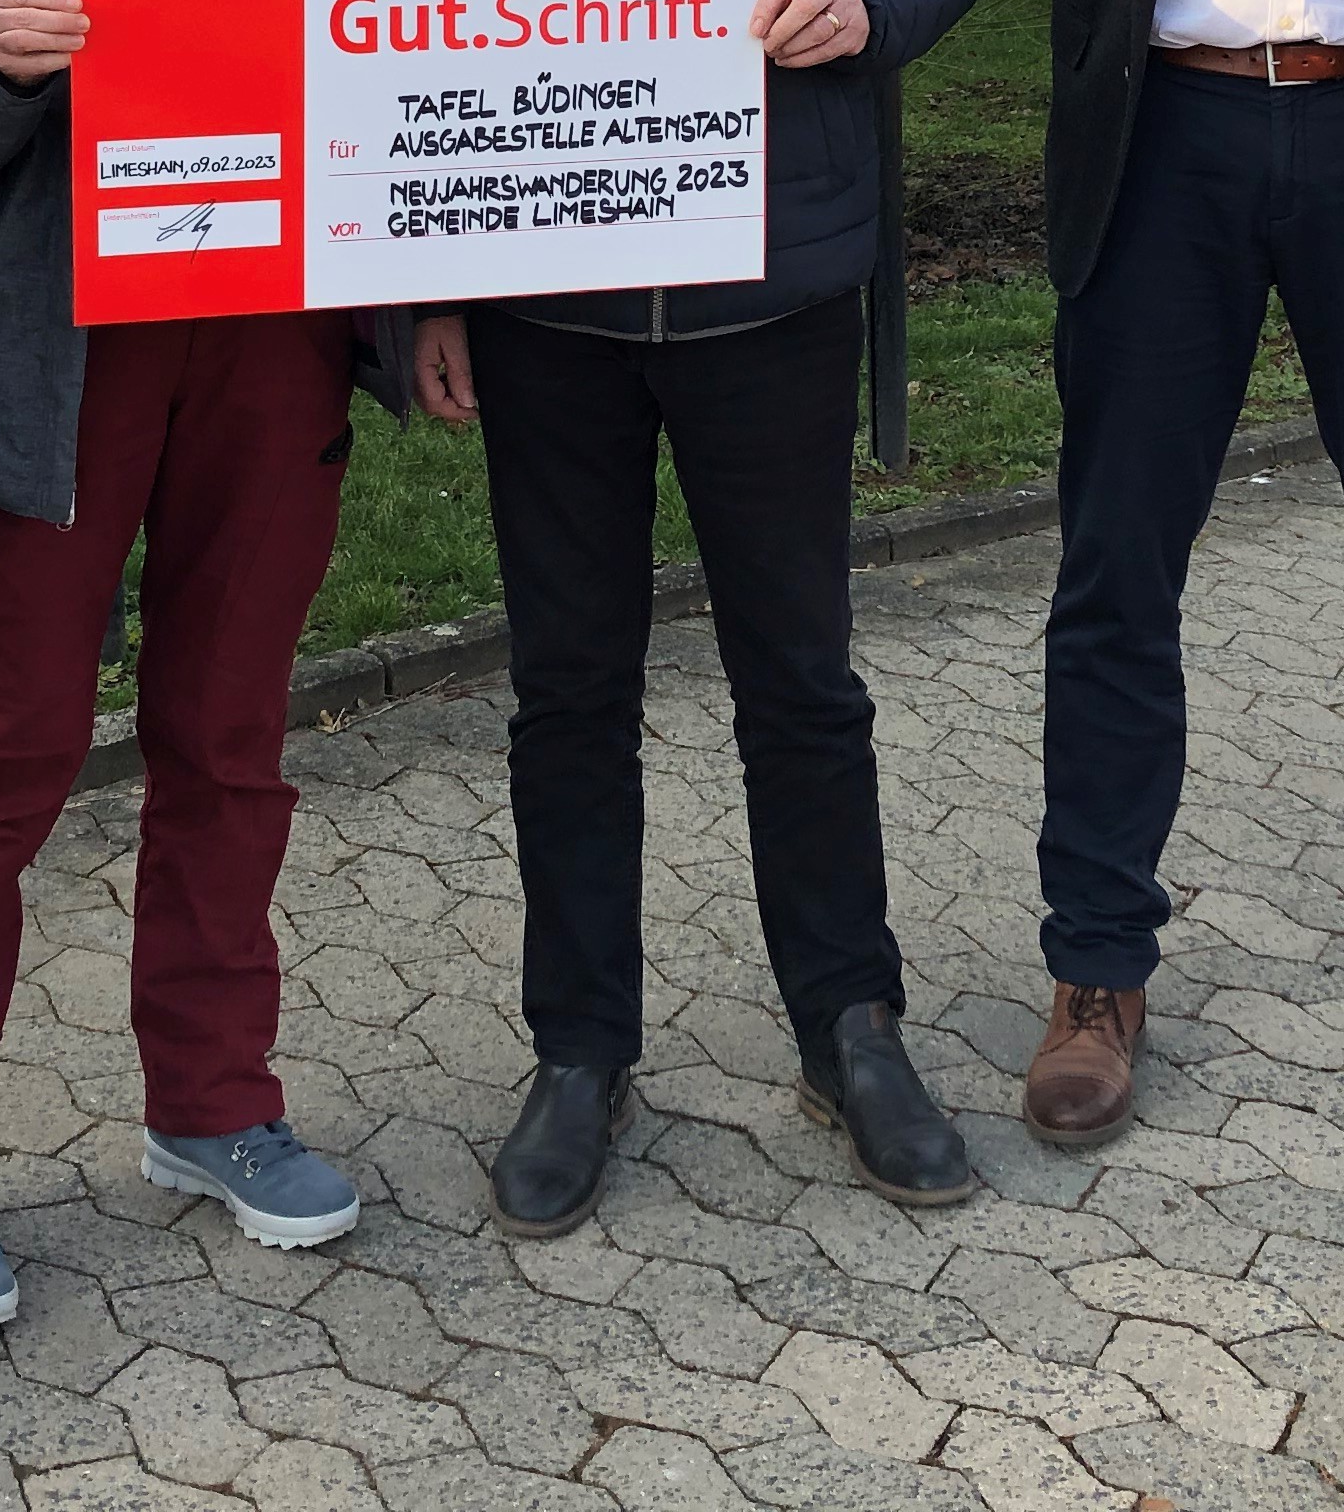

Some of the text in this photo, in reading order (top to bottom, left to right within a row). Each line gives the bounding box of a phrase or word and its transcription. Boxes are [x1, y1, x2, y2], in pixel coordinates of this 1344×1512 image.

[397, 71, 657, 123] TAFEL BÜDINGEN
[328, 140, 360, 159] für
[388, 107, 761, 159] AUSGABESTELLE ALTENSTADT
[389, 159, 749, 207] NEUJAHRSWANDERUNG 2023
[328, 221, 362, 238] von
[387, 194, 675, 238] GEMEINDE LIMESHAIN
